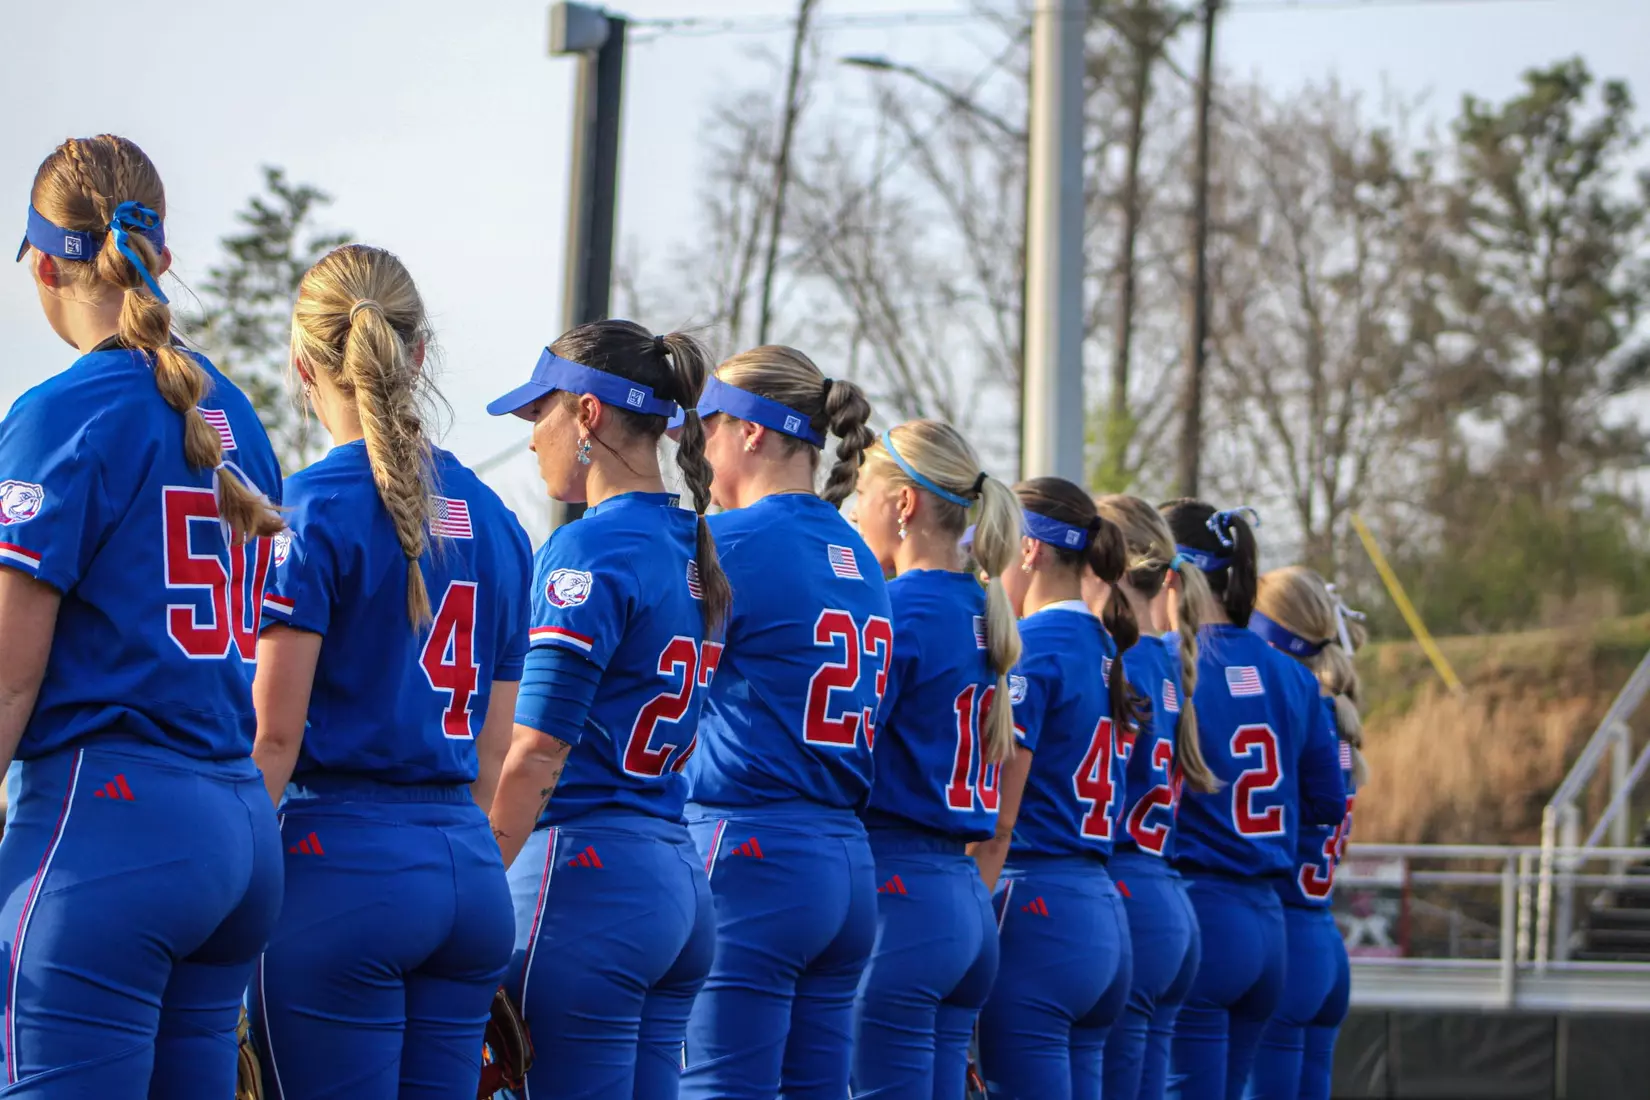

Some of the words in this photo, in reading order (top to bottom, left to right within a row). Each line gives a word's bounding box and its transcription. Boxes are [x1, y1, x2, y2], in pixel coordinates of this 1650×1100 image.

[162, 485, 275, 664] 50
[419, 579, 481, 740] 4
[803, 608, 894, 753] 23
[1229, 723, 1285, 838] 2
